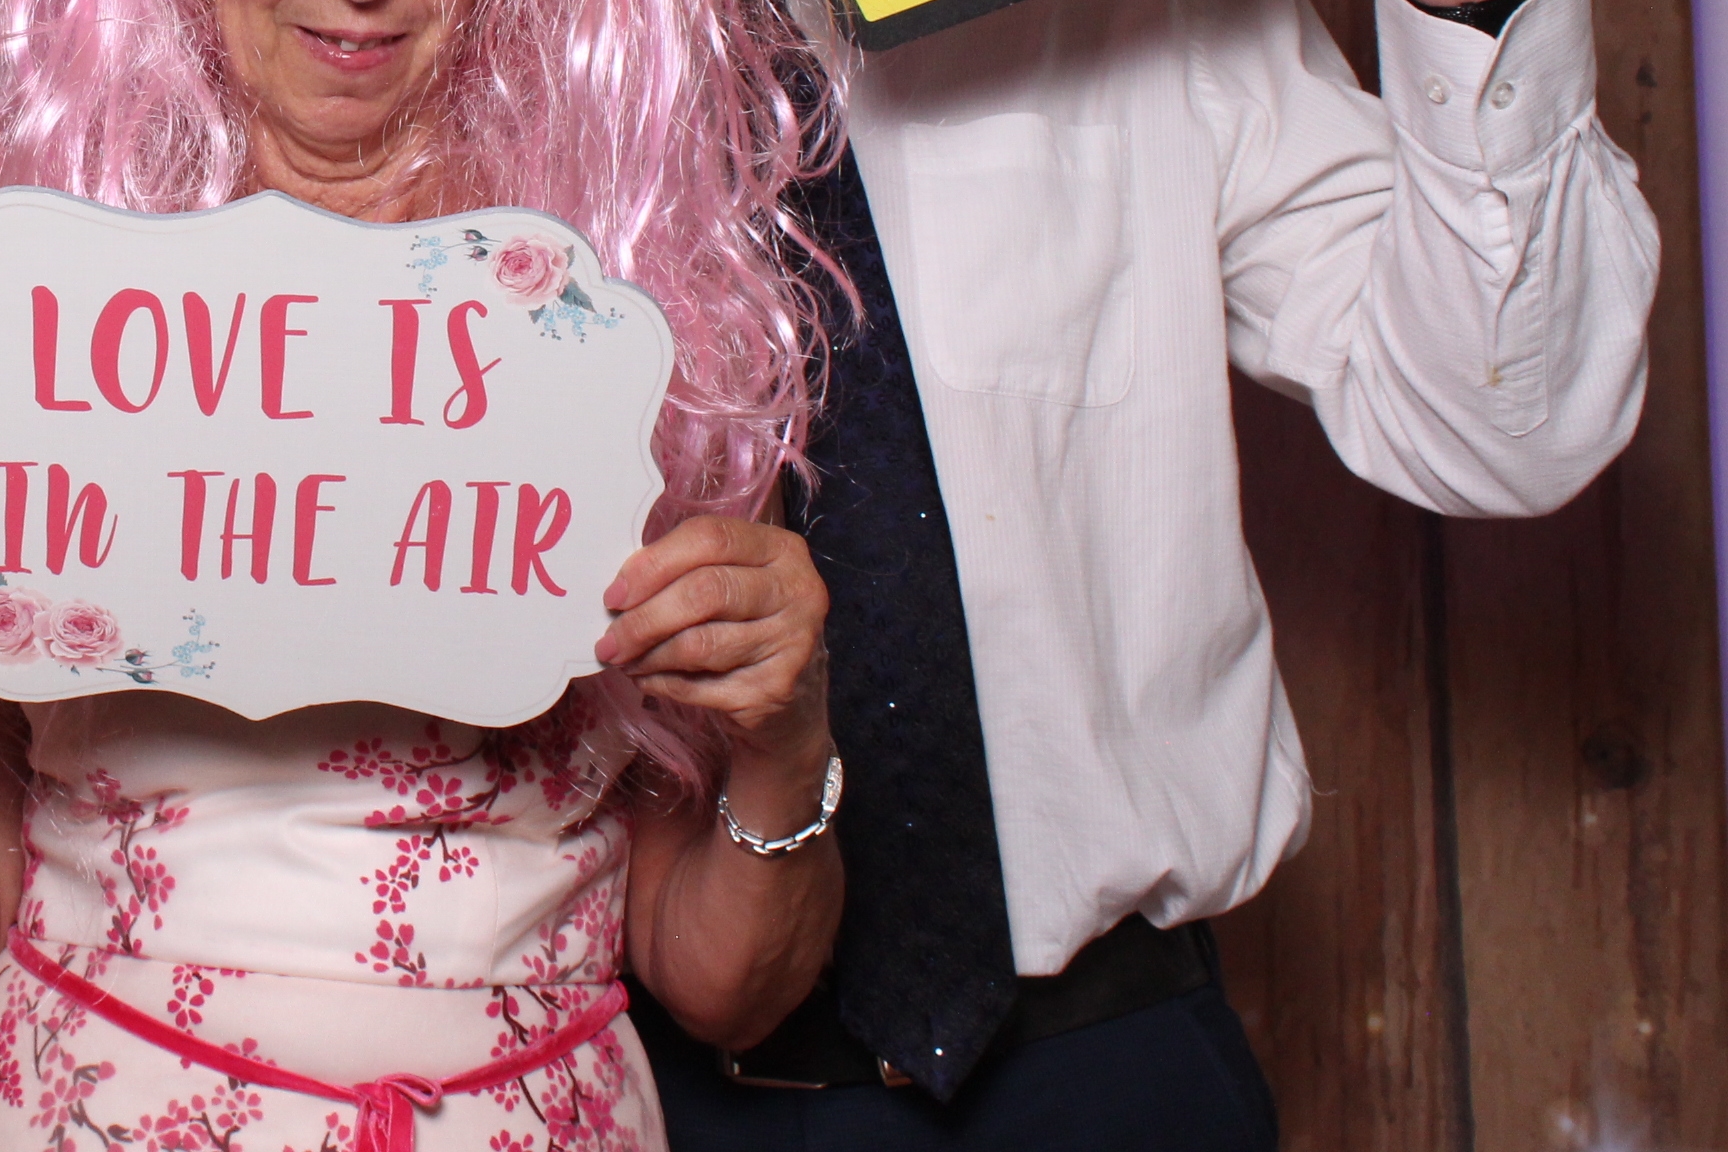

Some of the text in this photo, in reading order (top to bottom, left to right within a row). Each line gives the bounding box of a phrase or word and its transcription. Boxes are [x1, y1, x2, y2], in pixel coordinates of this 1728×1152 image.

[31, 285, 501, 430] LOVE IS
[167, 469, 346, 586] THE
[389, 479, 572, 597] AIR
